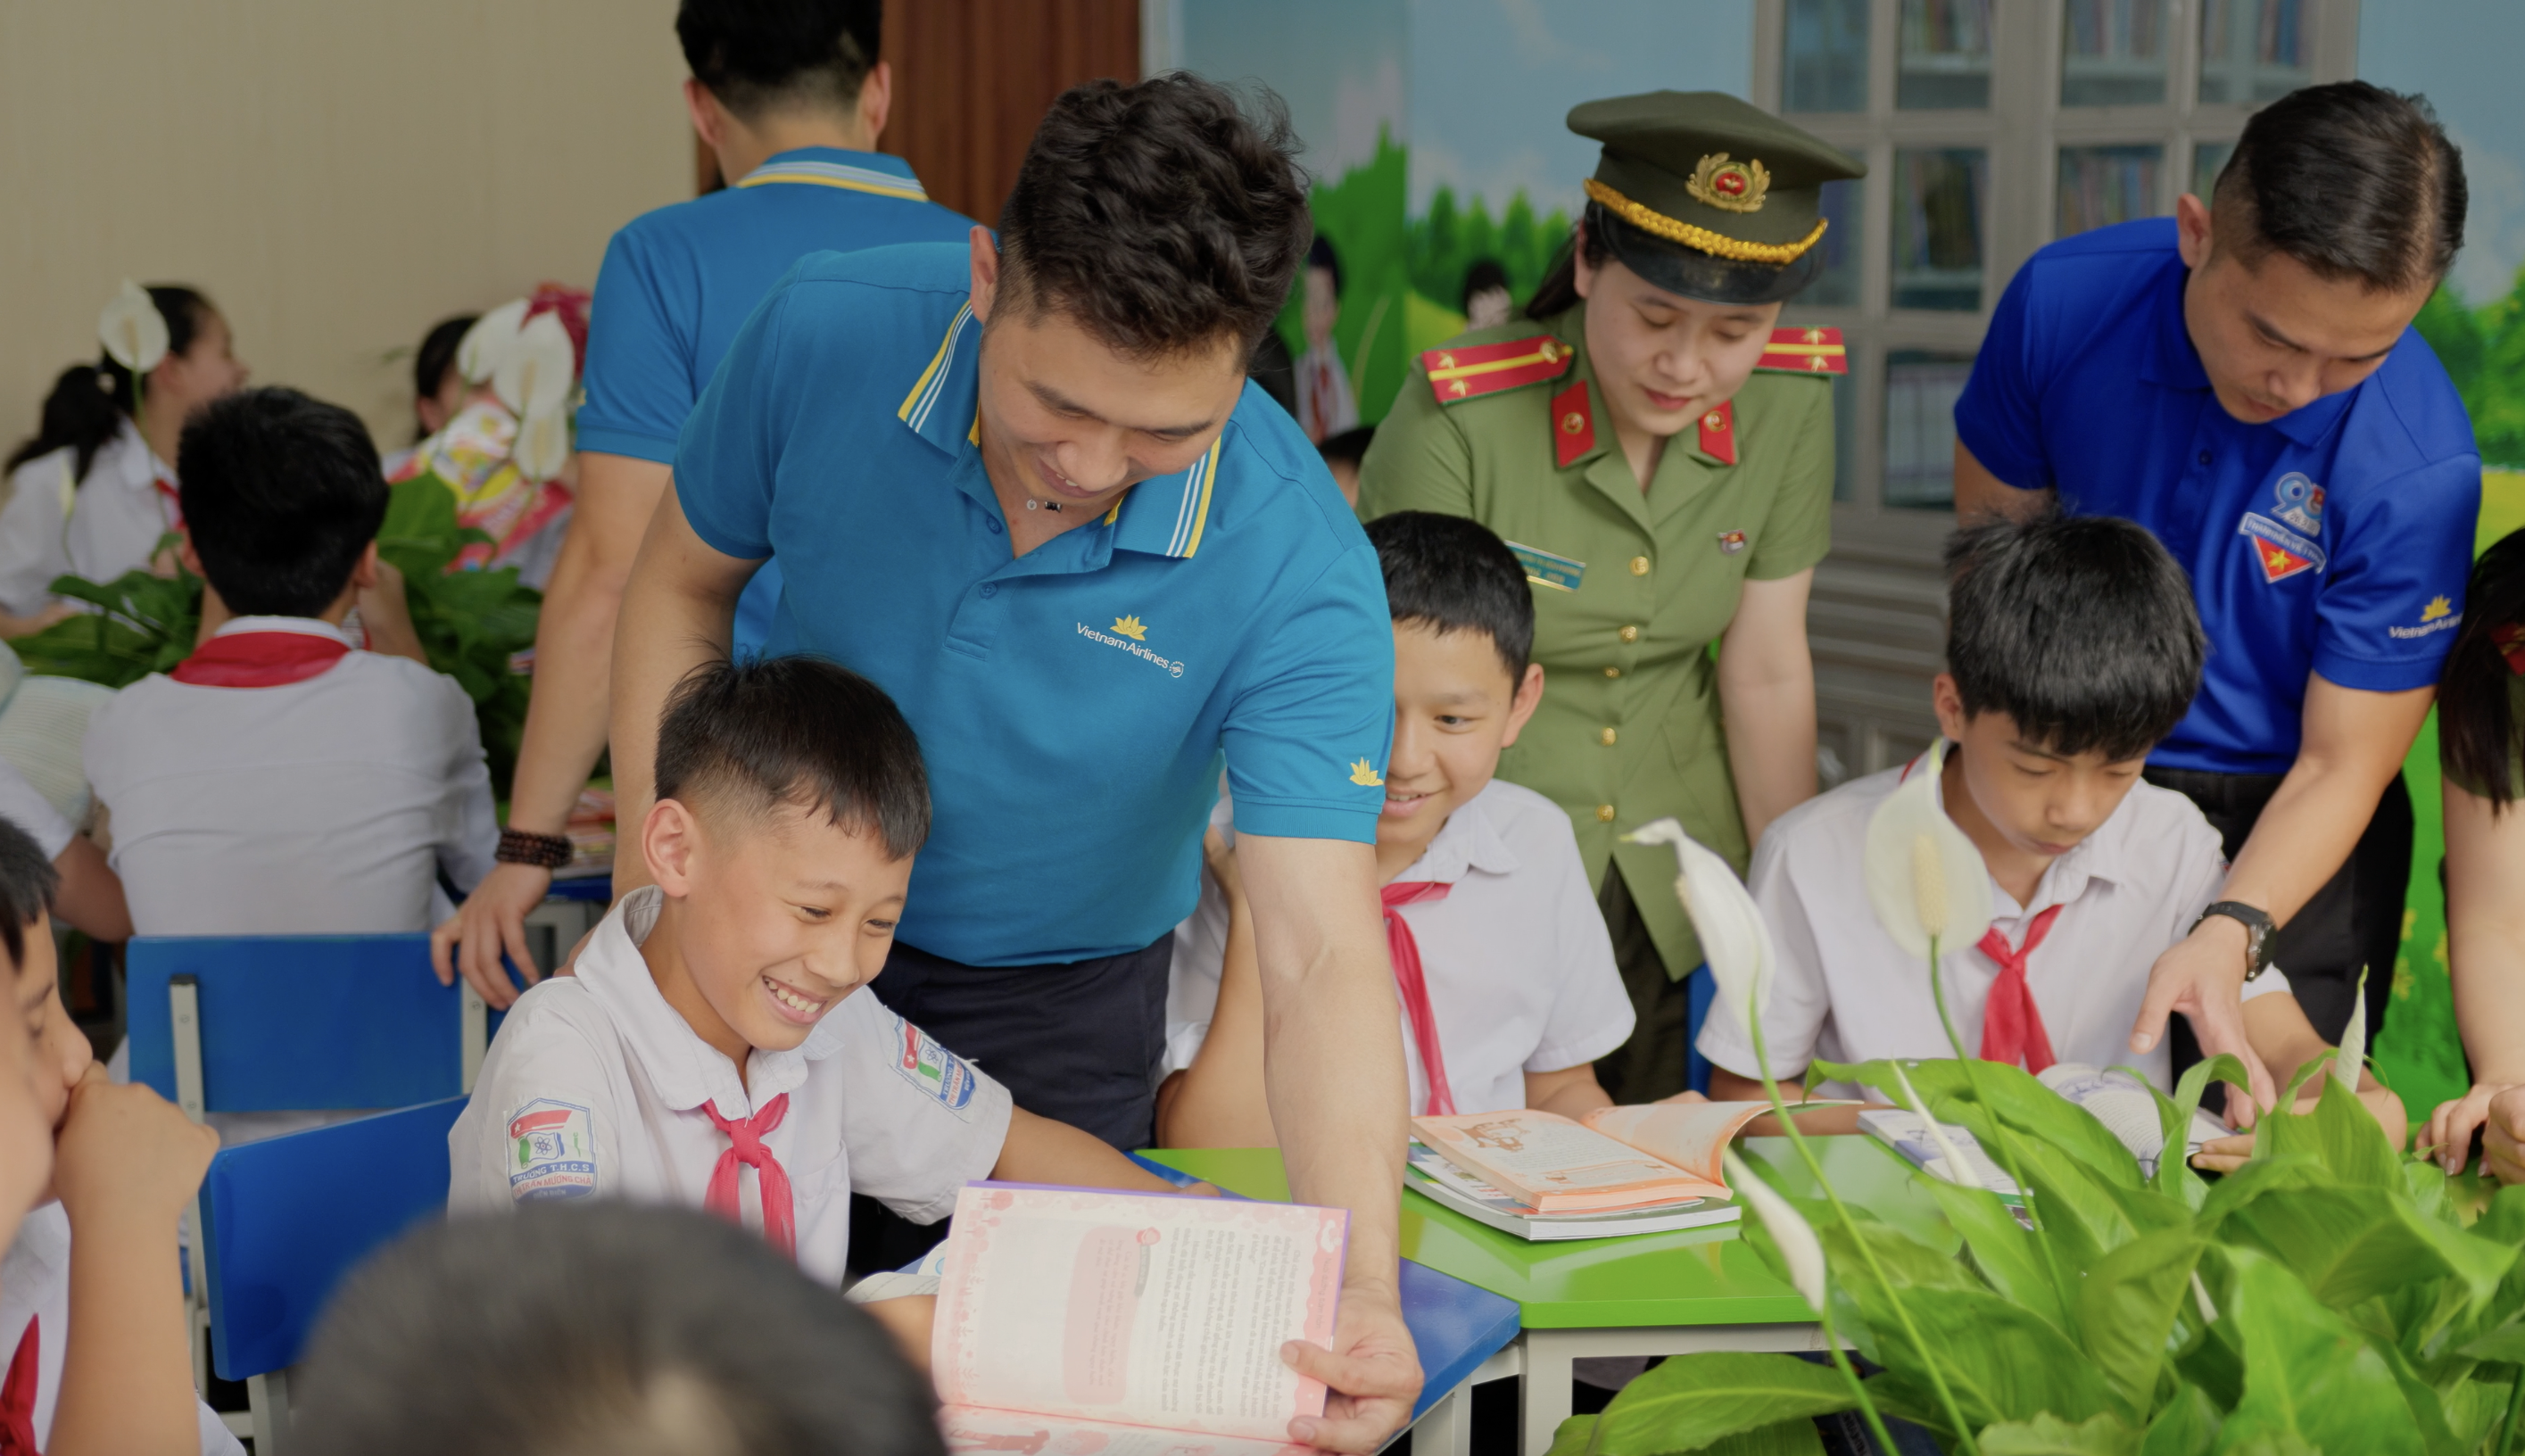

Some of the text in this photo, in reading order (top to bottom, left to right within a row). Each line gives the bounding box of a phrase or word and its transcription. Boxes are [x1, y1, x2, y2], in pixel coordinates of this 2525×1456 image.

[1077, 622, 1170, 669] Vietnam Airlines
[550, 1163, 590, 1172] T.H.C.S
[575, 1175, 592, 1185] CHÀ
